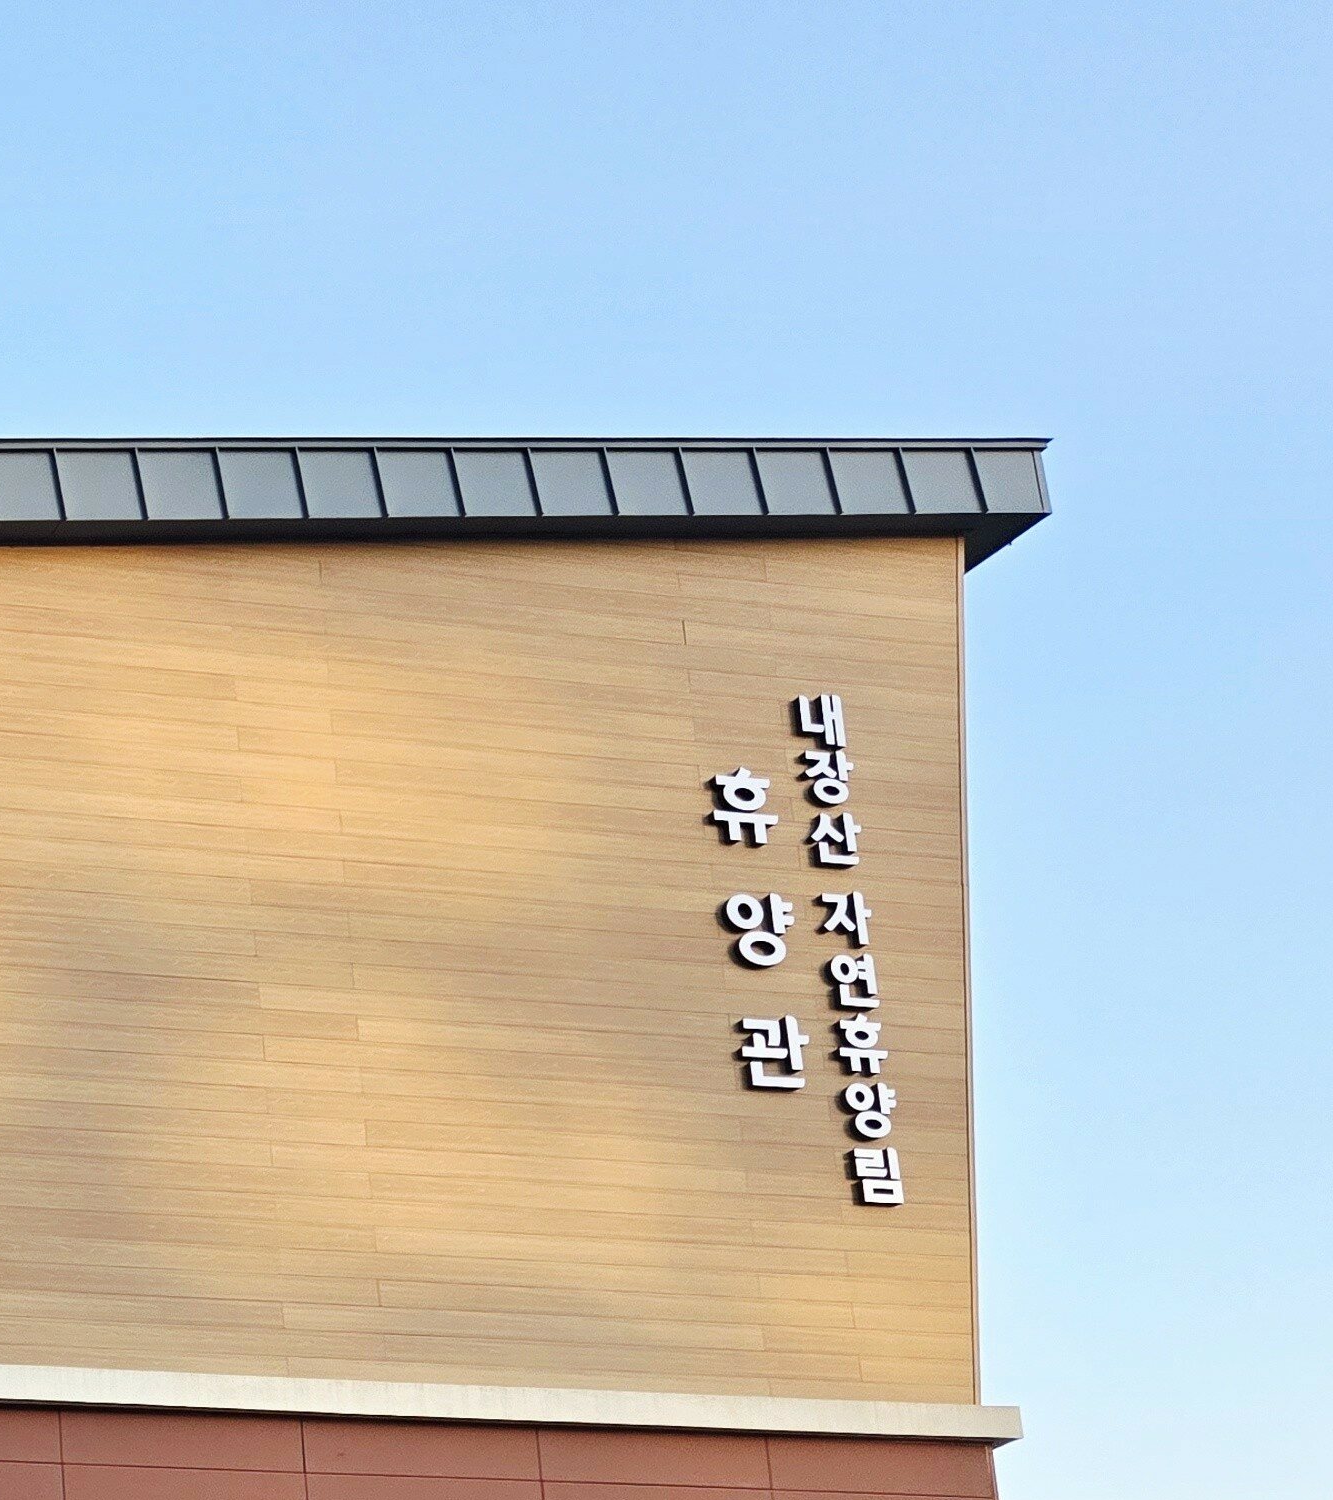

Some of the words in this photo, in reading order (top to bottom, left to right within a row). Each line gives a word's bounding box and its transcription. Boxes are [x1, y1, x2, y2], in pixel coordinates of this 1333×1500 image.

[711, 767, 809, 1090] 휴양관
[797, 694, 863, 868] 내장산
[820, 891, 905, 1208] 자연휴양림
